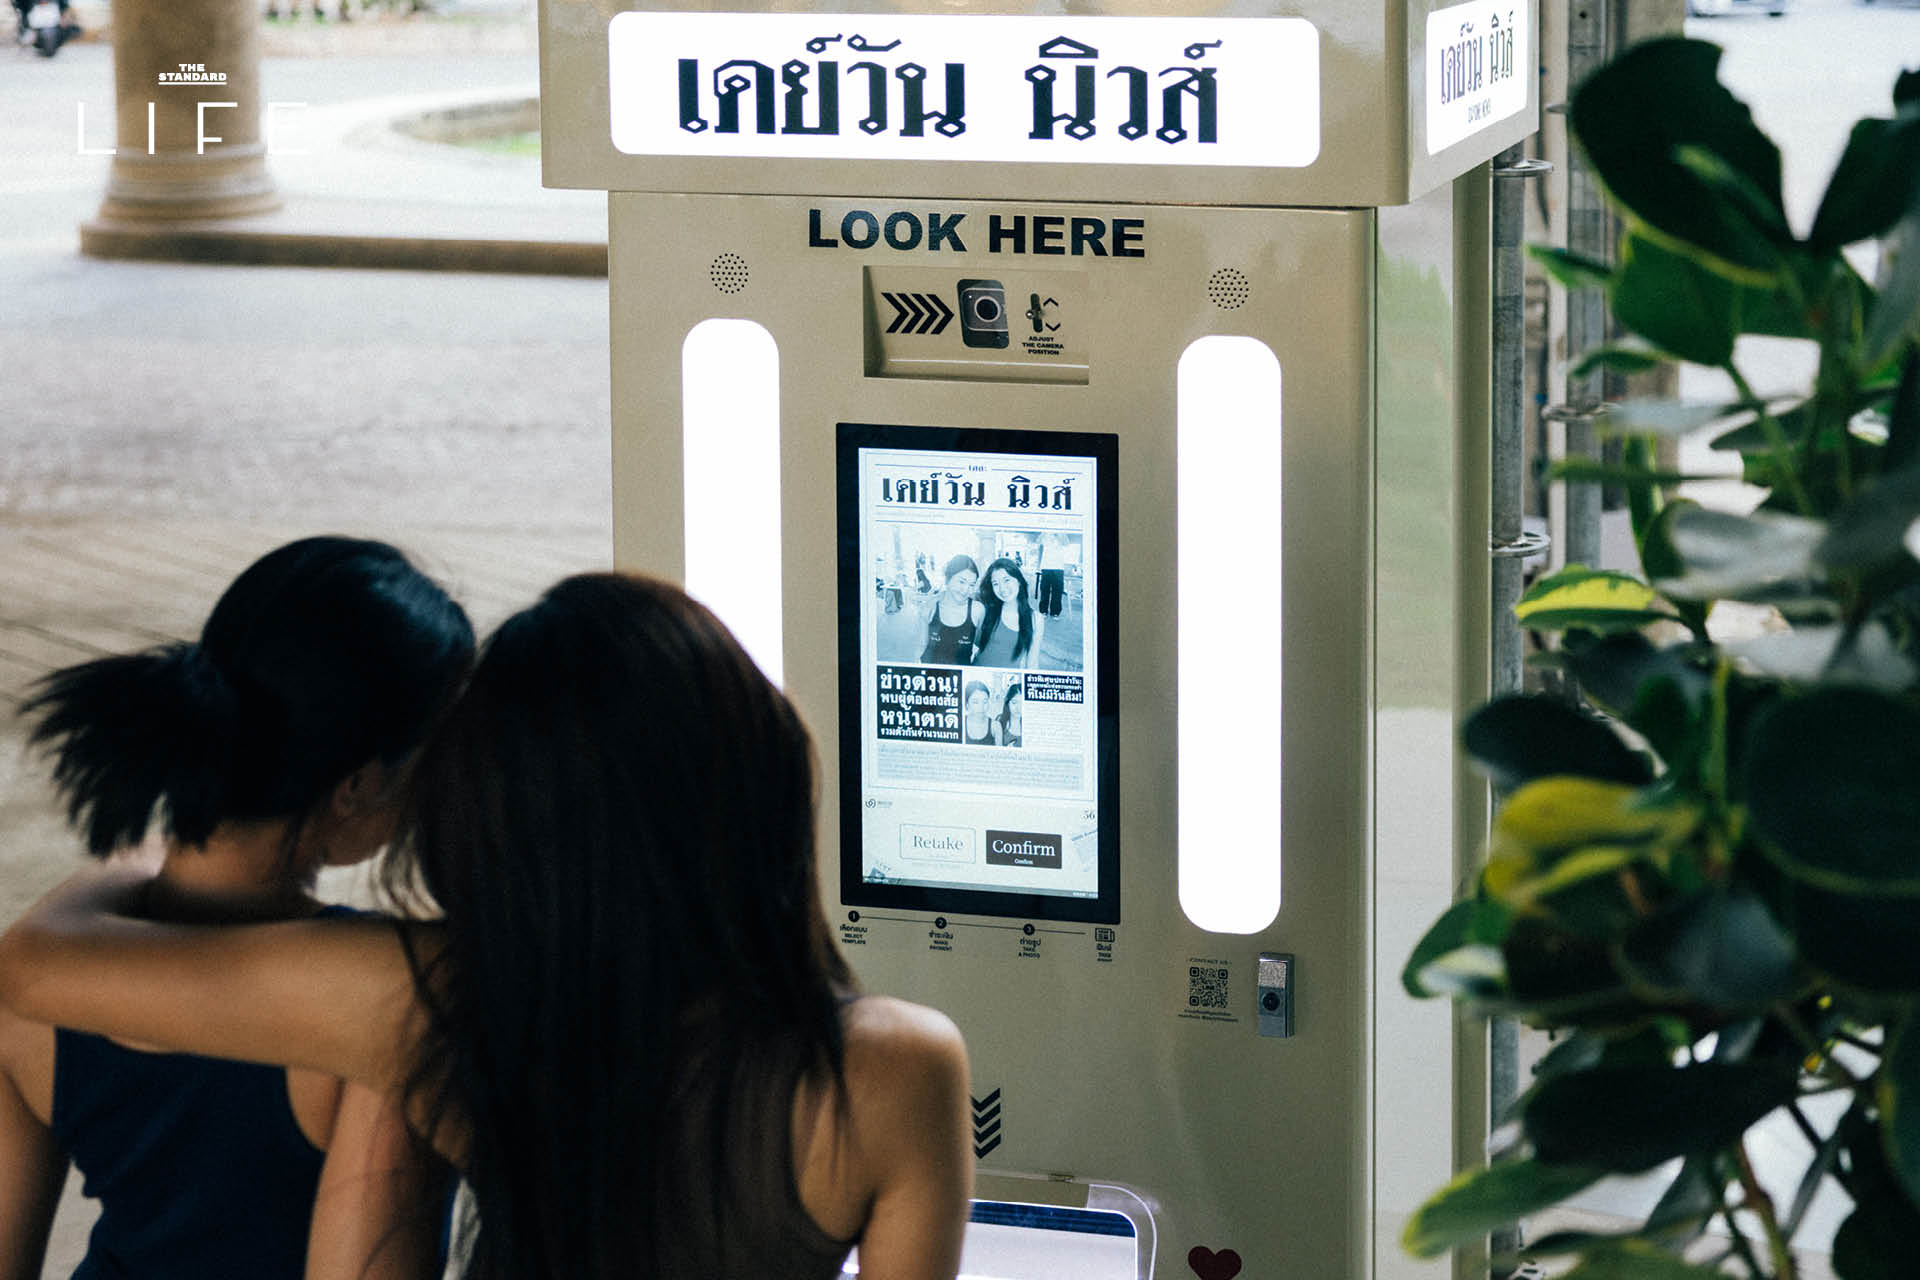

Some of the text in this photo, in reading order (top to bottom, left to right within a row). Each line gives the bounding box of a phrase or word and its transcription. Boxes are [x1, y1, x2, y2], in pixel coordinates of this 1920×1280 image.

[1489, 9, 1514, 85] นิวส์
[1025, 36, 1222, 144] นิวส์
[809, 209, 1145, 257] LOOK HERE
[1006, 475, 1076, 510] นิวส์
[880, 668, 959, 693] ข่าวด่วน!
[880, 690, 959, 708] พบผู้ต้องสงสัย
[1027, 688, 1082, 702] ที่ไม่มีวันลืม!
[880, 705, 959, 729] หน้าตาดี
[880, 727, 959, 740] รวมตัวกันจำนวนมาก
[912, 834, 965, 851] Retake
[992, 839, 1056, 857] Confirm
